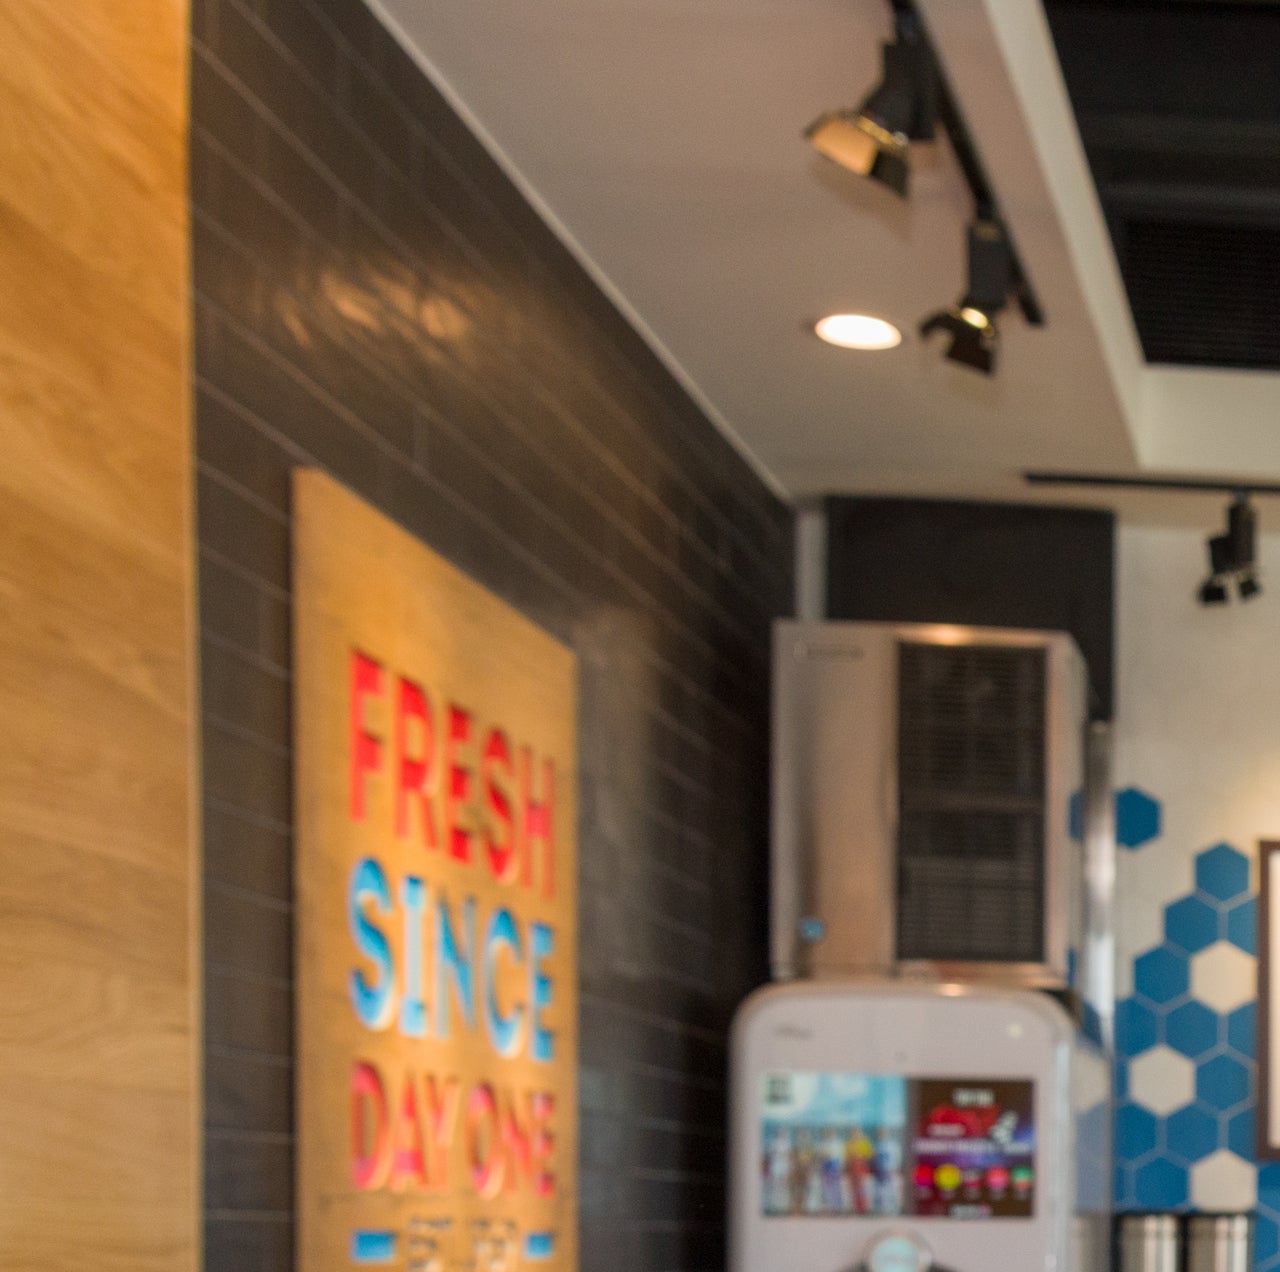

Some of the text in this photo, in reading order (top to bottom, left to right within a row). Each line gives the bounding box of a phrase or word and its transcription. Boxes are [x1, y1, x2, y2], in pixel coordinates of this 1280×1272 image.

[349, 648, 557, 898] FRESH
[348, 856, 557, 1062] SINCE
[350, 1059, 557, 1199] DAY ONE
